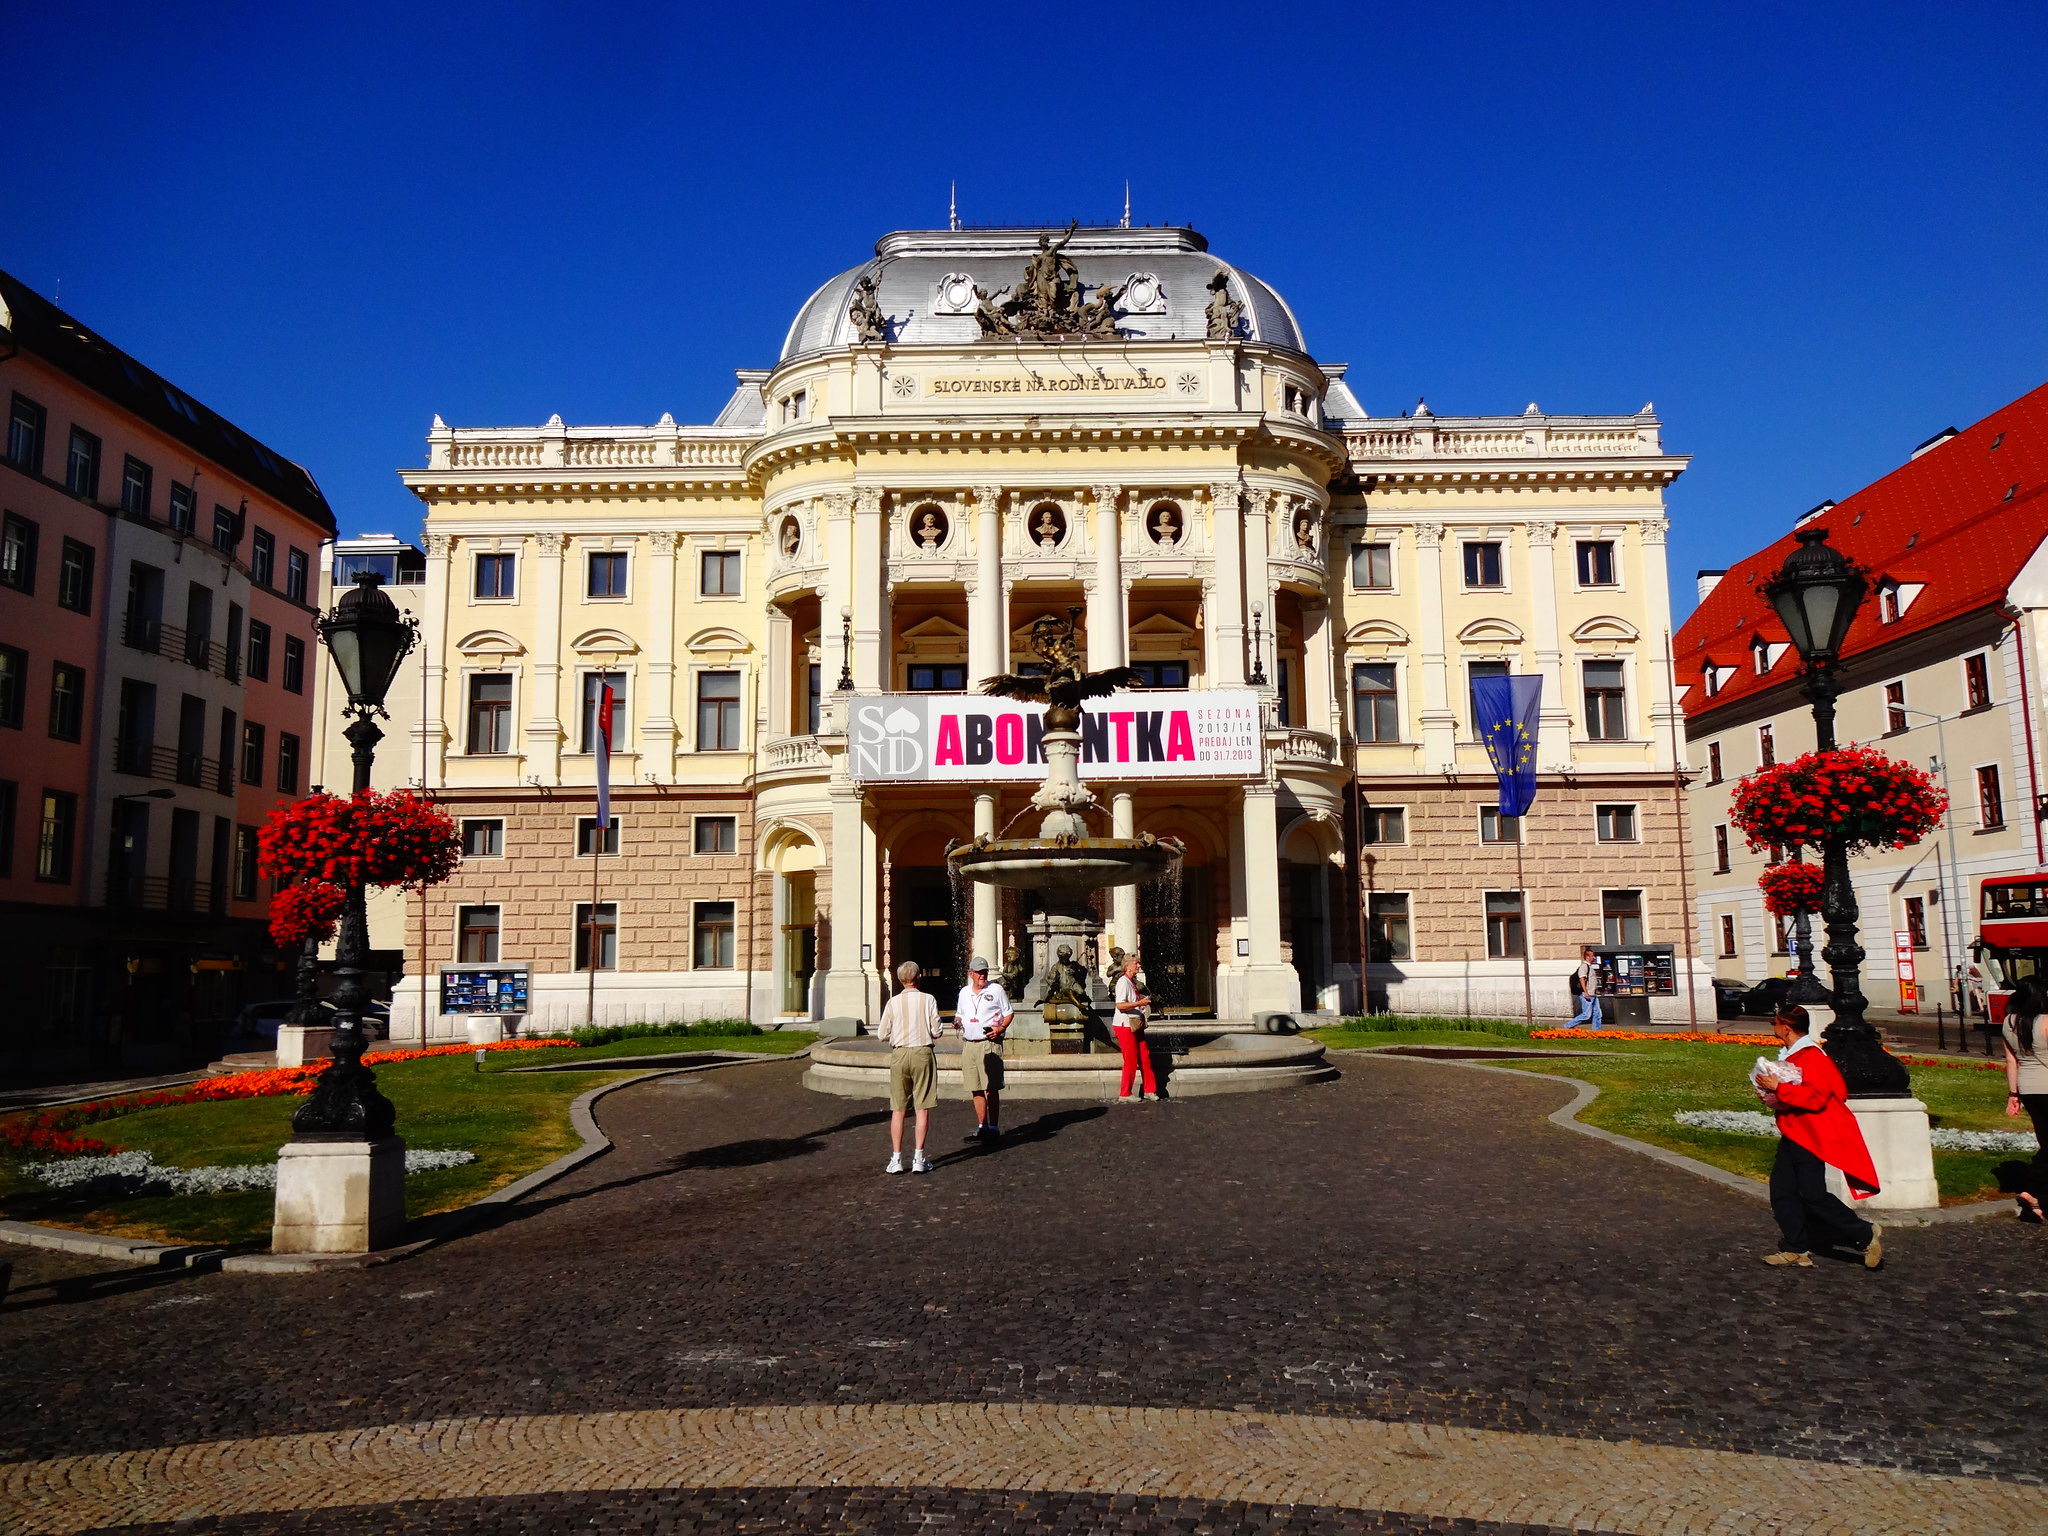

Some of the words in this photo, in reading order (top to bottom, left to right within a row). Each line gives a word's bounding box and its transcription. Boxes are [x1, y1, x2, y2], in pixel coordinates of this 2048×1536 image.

[1104, 377, 1166, 391] DIVADLO
[1198, 722, 1251, 733] 2013/14
[935, 710, 1195, 765] ABONNTKA
[1199, 737, 1232, 747] PREDAJ
[1236, 736, 1252, 746] LEN
[1199, 751, 1211, 761] DO
[1214, 750, 1252, 760] 31.7.2013
